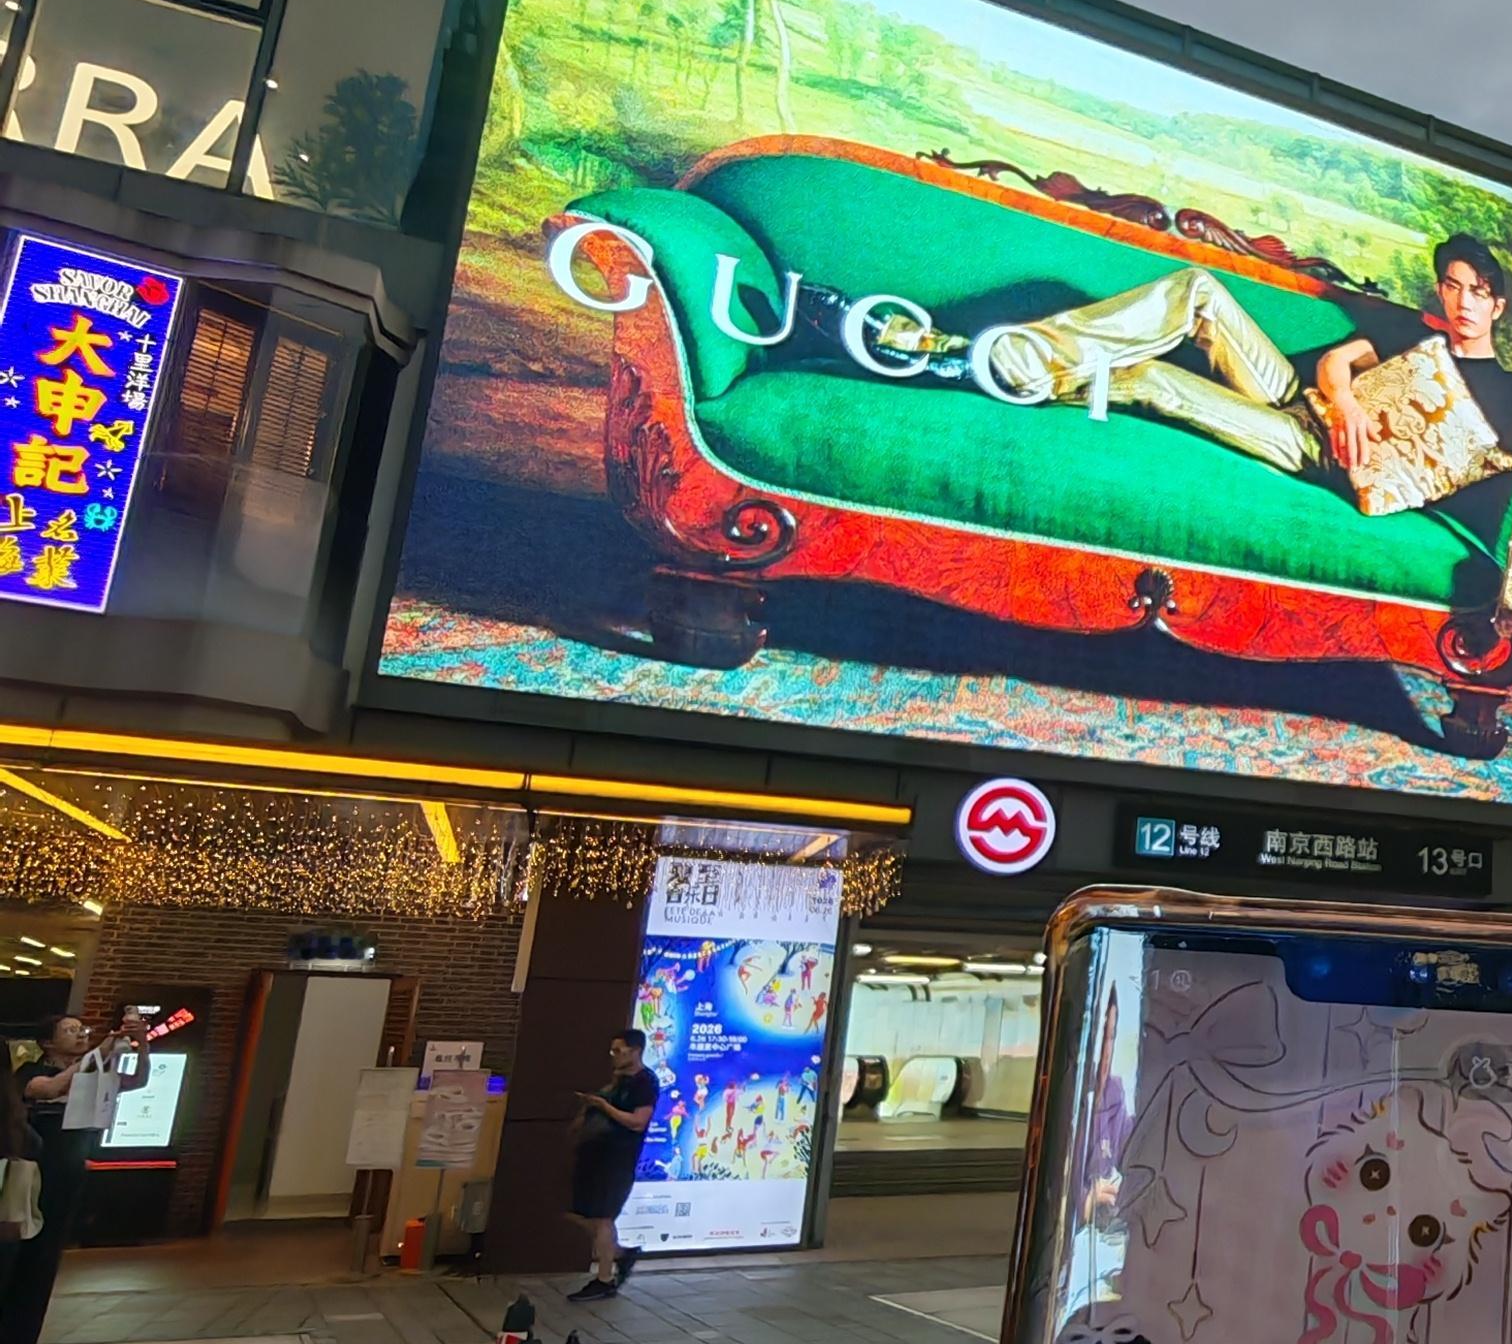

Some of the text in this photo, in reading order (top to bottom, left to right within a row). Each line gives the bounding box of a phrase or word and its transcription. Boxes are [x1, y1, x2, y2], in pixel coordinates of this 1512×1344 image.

[30, 283, 151, 329] SHANGHAI
[548, 221, 1111, 422] GUCCI
[12, 312, 116, 494] 大申記
[1141, 823, 1171, 853] 12
[1179, 845, 1198, 856] Line
[1265, 828, 1379, 860] 南京西路站
[1260, 853, 1285, 865] West
[1324, 859, 1349, 869] Road
